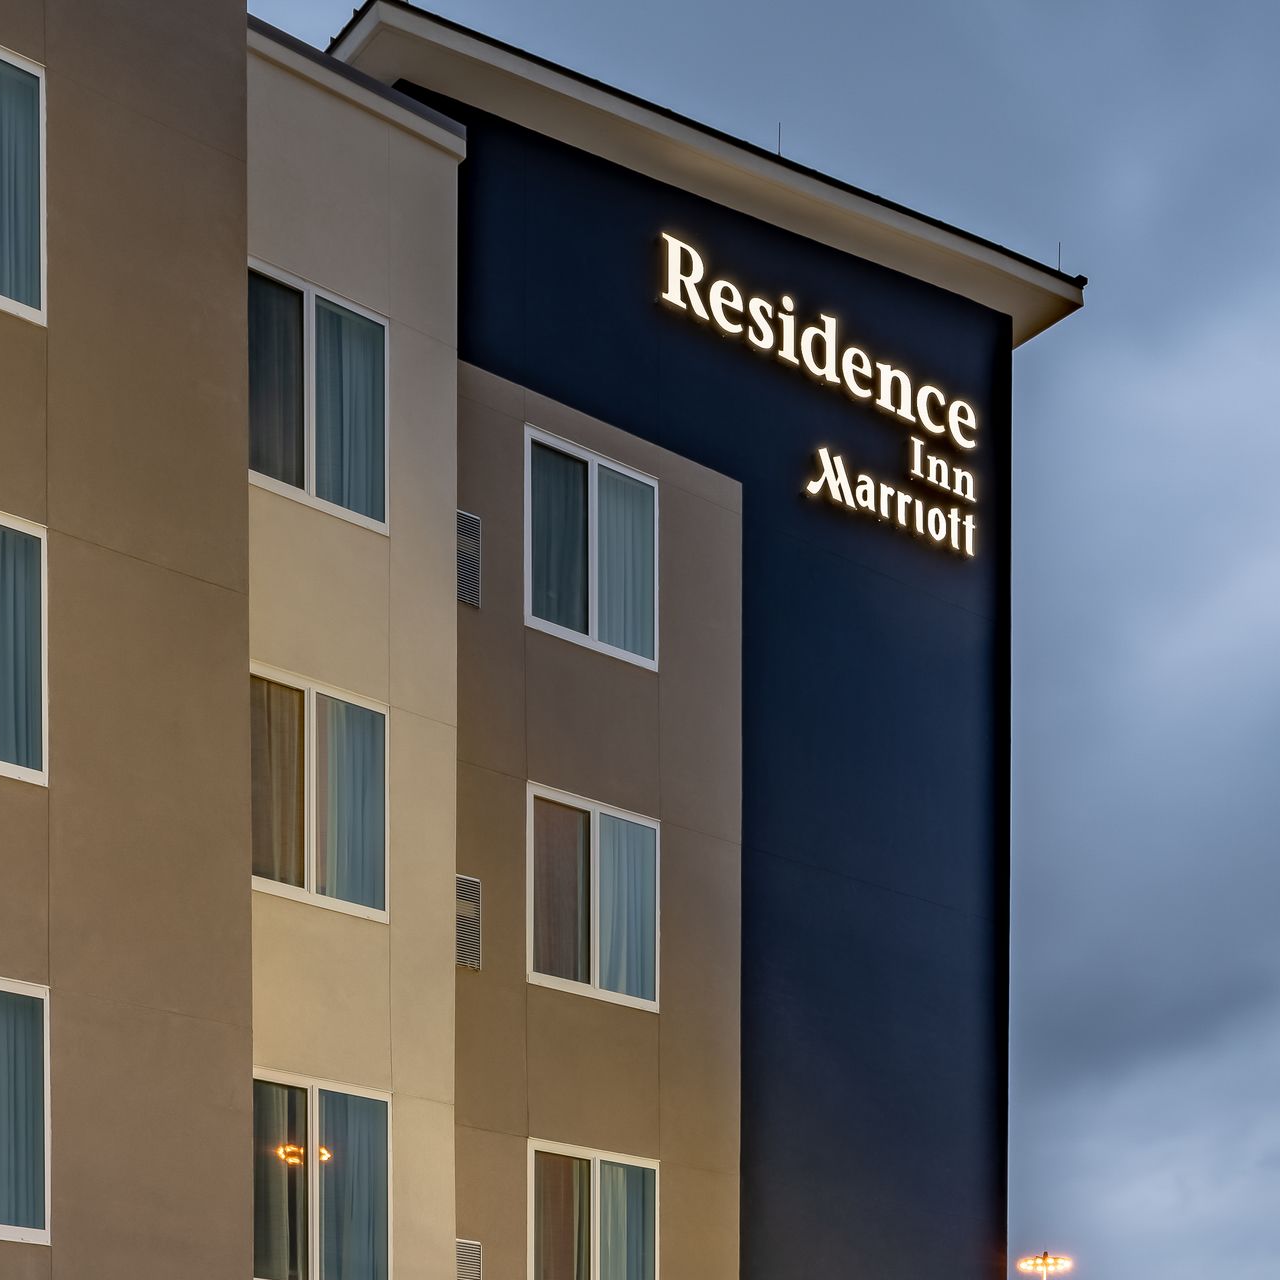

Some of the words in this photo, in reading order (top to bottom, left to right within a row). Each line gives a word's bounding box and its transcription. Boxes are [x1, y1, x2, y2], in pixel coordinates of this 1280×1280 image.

[662, 232, 976, 449] Residence
[806, 447, 976, 556] Marriott
[911, 436, 976, 502] Inn
